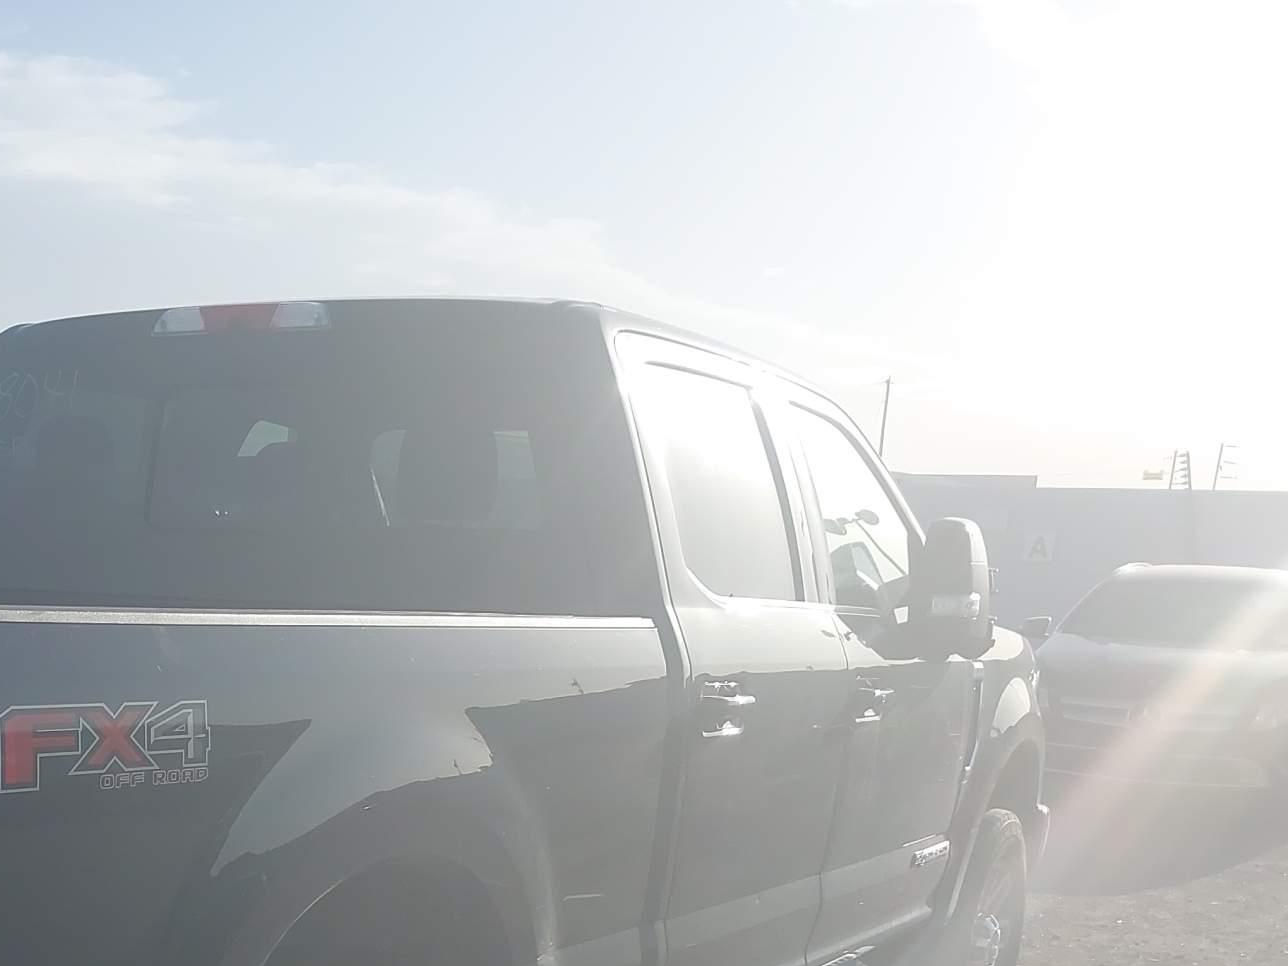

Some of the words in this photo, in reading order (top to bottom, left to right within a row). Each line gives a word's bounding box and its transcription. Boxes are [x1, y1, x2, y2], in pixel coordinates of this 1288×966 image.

[1029, 536, 1047, 558] A
[100, 772, 145, 790] OFF
[152, 767, 209, 786] ROAD
